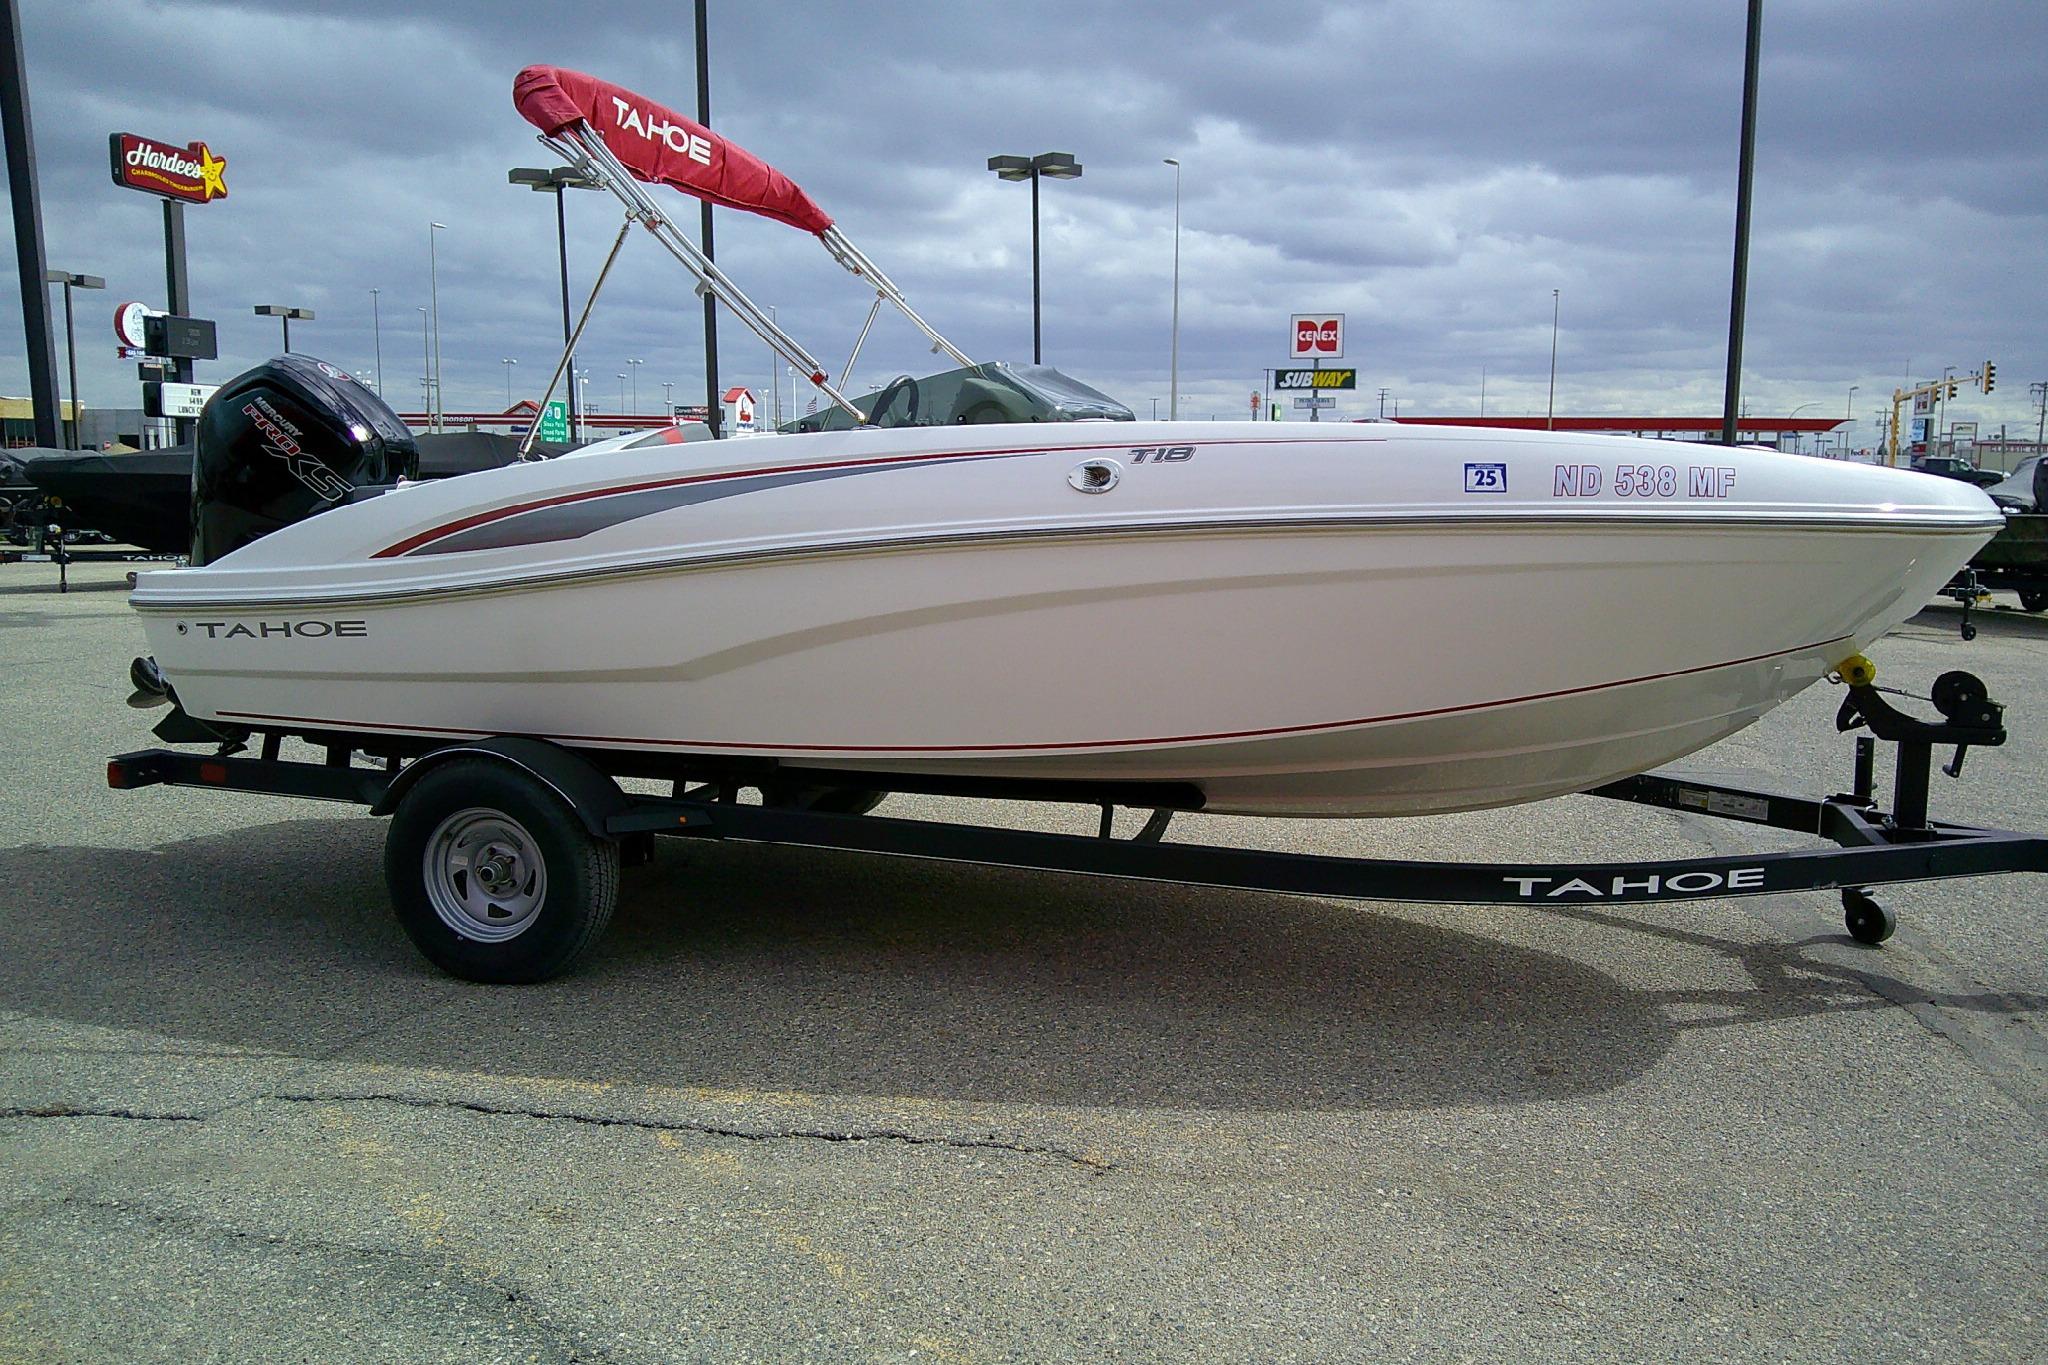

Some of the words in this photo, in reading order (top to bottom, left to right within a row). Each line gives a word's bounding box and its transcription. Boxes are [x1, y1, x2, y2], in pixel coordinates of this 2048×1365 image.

[612, 95, 711, 166] TAHOE
[126, 142, 204, 178] Hardee's
[1299, 330, 1337, 341] CENEX
[1279, 371, 1352, 388] SUBWAY
[241, 402, 301, 456] PRO
[254, 396, 304, 437] MERCURY
[1128, 446, 1198, 464] T18
[260, 444, 356, 502] XS
[1474, 469, 1497, 487] 25
[1553, 465, 1602, 496] ND
[1614, 465, 1677, 497] 538
[1688, 466, 1736, 497] MF
[196, 620, 368, 639] TAHOE
[1502, 867, 1765, 896] TAHOE
